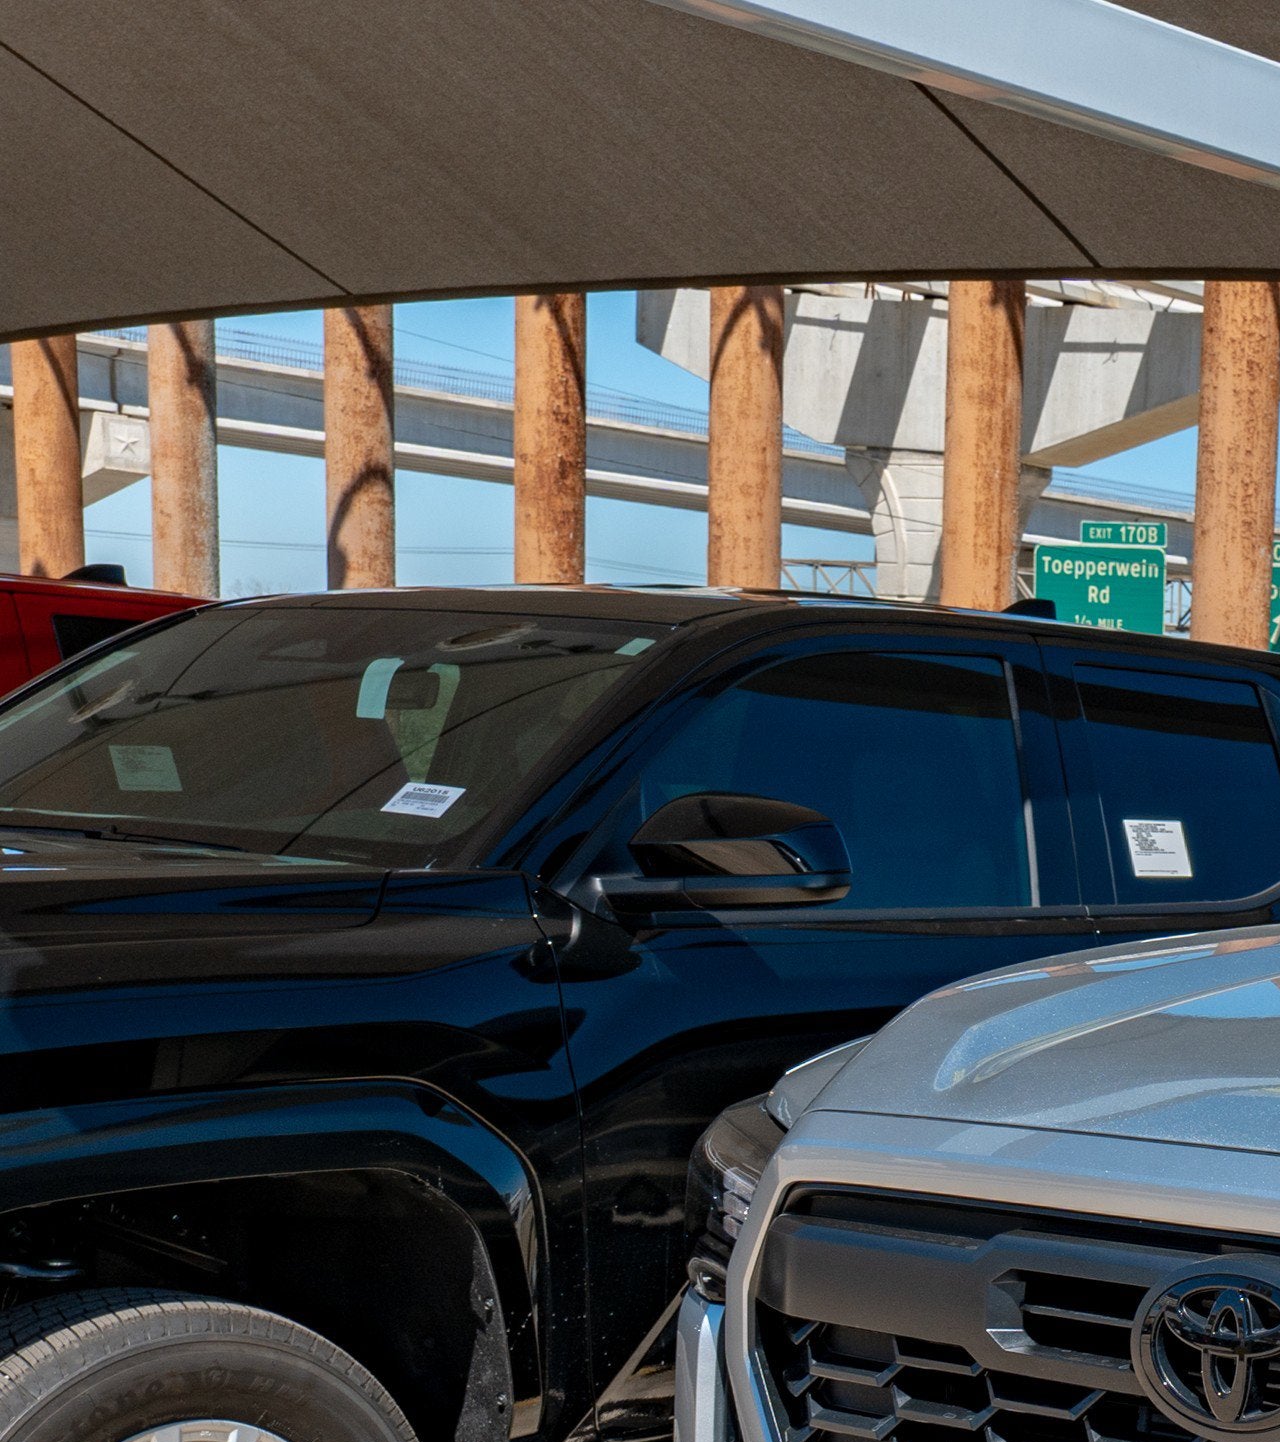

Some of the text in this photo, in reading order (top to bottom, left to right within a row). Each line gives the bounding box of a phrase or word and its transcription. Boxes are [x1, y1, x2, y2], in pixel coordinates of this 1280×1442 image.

[1089, 525, 1159, 543] EXIT 170B
[1041, 555, 1160, 579] Toepperwein
[1087, 584, 1111, 605] Rd
